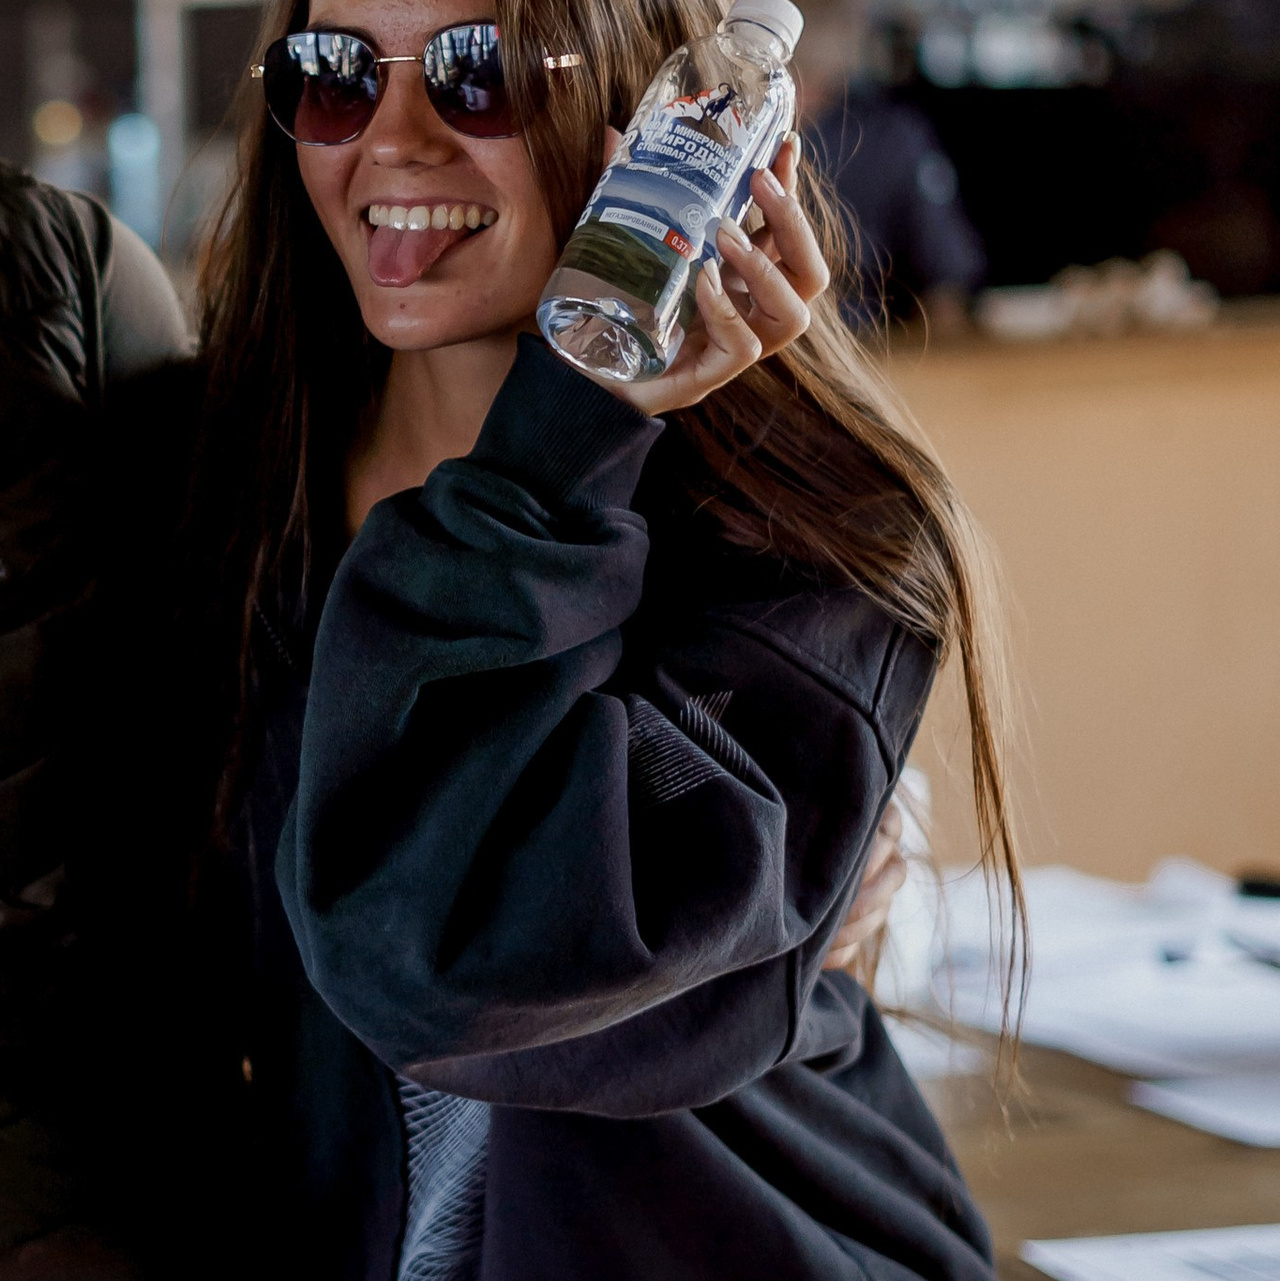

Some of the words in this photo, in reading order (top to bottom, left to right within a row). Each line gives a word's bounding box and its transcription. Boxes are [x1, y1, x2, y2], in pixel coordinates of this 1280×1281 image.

[636, 142, 686, 160] СТОЛОВАЯ
[641, 130, 734, 178] ПРИРОДНАЯ
[673, 122, 740, 168] МИНЕРАЛЬНАЯ
